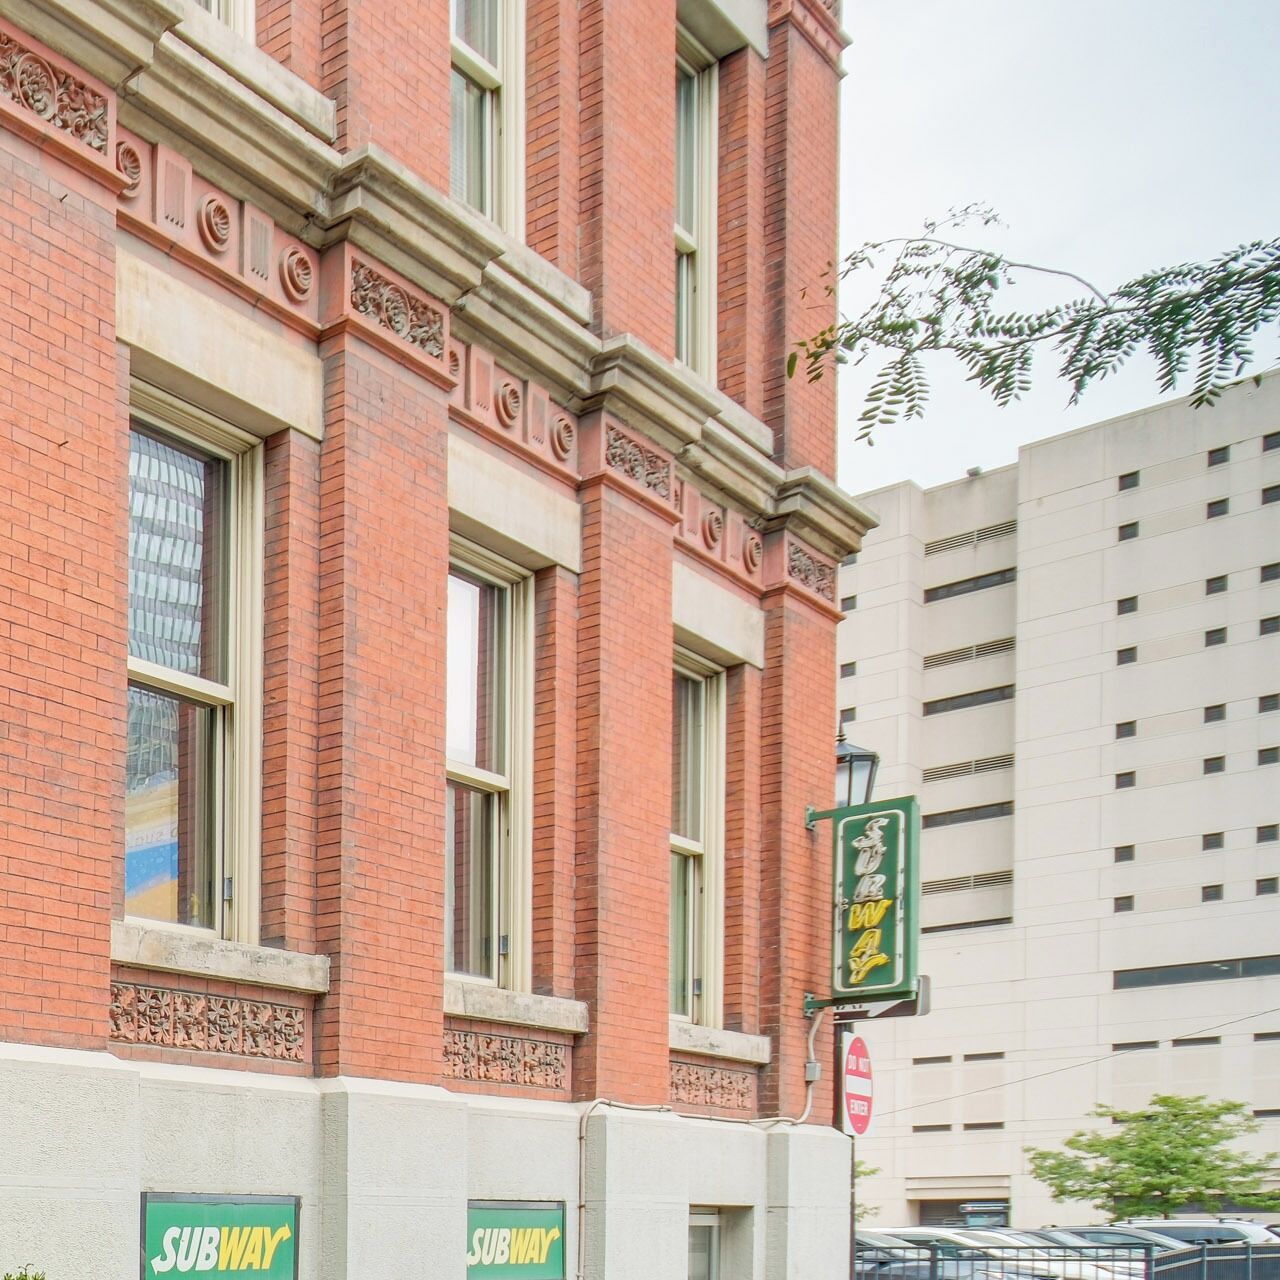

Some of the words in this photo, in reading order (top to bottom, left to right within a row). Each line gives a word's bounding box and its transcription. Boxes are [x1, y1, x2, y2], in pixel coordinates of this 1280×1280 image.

[847, 816, 894, 985] SUBWAY
[847, 1054, 857, 1071] DO
[858, 1056, 870, 1073] NOT
[850, 1098, 869, 1117] ENTER
[150, 1223, 292, 1276] SUBWAY
[466, 1224, 561, 1268] SUBWAY
